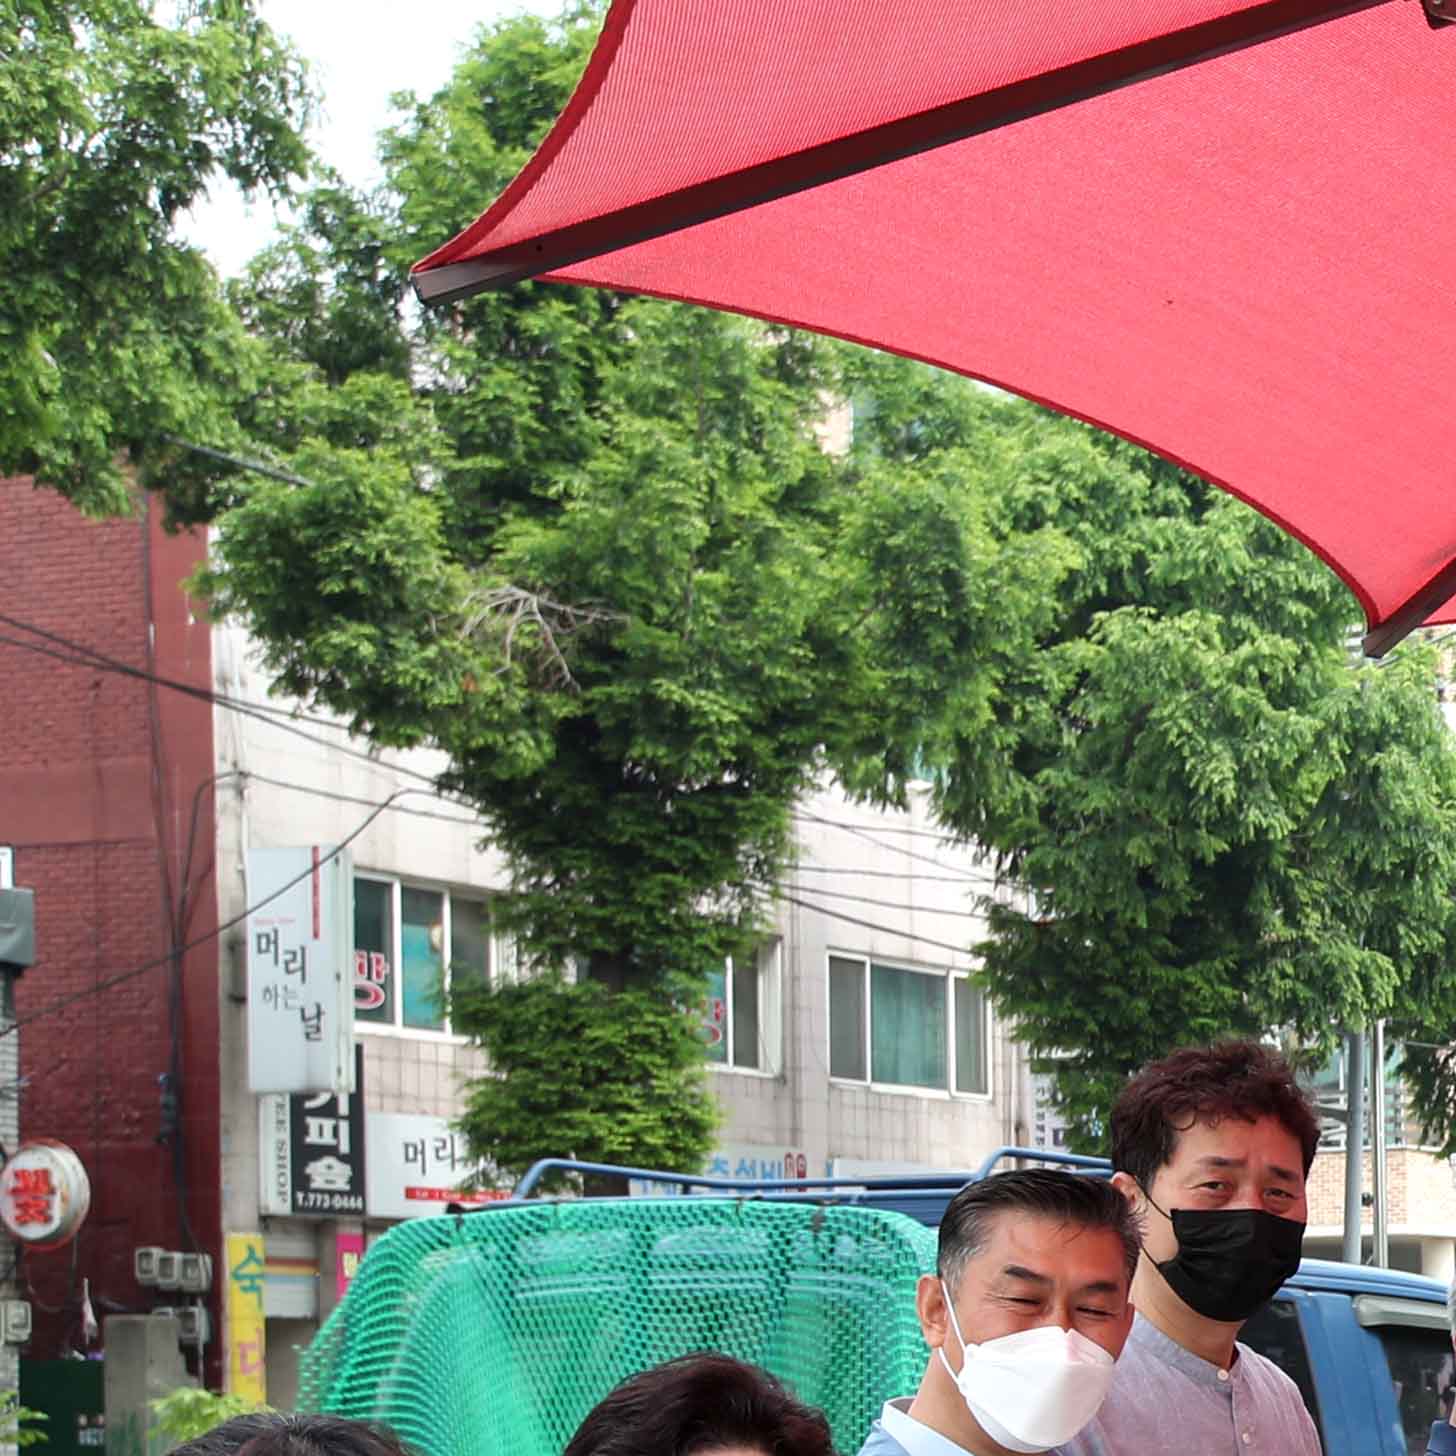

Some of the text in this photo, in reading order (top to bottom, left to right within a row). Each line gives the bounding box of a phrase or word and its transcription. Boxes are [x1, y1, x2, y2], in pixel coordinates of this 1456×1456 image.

[256, 928, 306, 985] 머리
[263, 984, 299, 1011] 하는
[300, 1002, 326, 1041] 날
[403, 1133, 456, 1176] 머리
